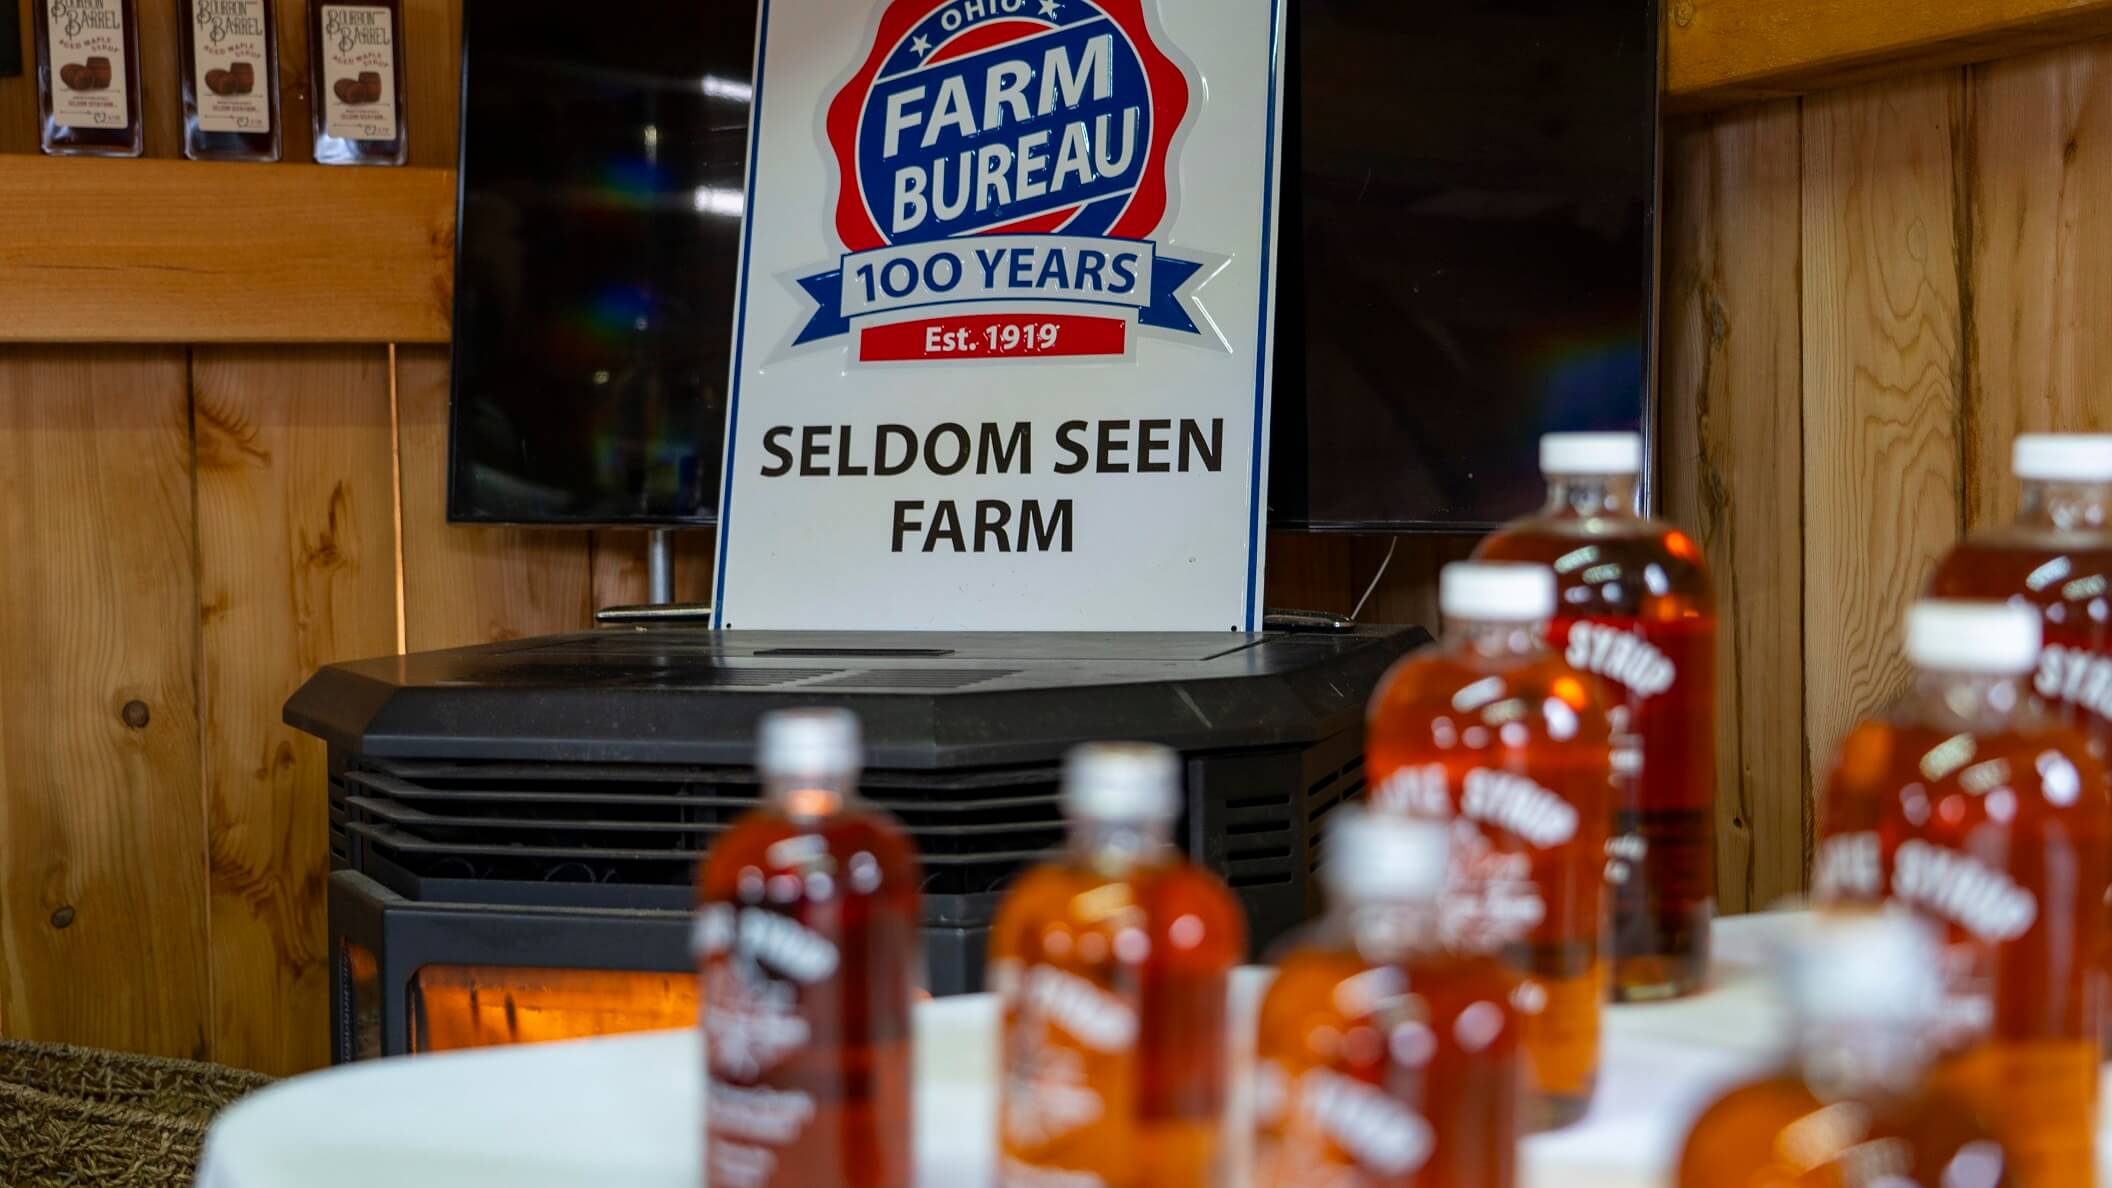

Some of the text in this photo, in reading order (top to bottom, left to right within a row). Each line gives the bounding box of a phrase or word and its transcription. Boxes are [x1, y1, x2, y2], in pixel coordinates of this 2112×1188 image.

[64, 9, 120, 40] BARREL
[209, 16, 263, 45] BARREL
[326, 10, 382, 40] BOURBON
[339, 26, 391, 55] BARREL
[941, 0, 1021, 31] OHIO
[882, 33, 1114, 160] FARM
[891, 106, 1140, 234] BUREAU
[856, 247, 1138, 303] 100 YEARS
[925, 323, 1058, 353] Est. 1919
[760, 418, 1224, 477] SELDOM SEEN
[891, 499, 1074, 553] FARM
[1565, 620, 1676, 696] SYRUP
[1461, 766, 1580, 848] SYRUP
